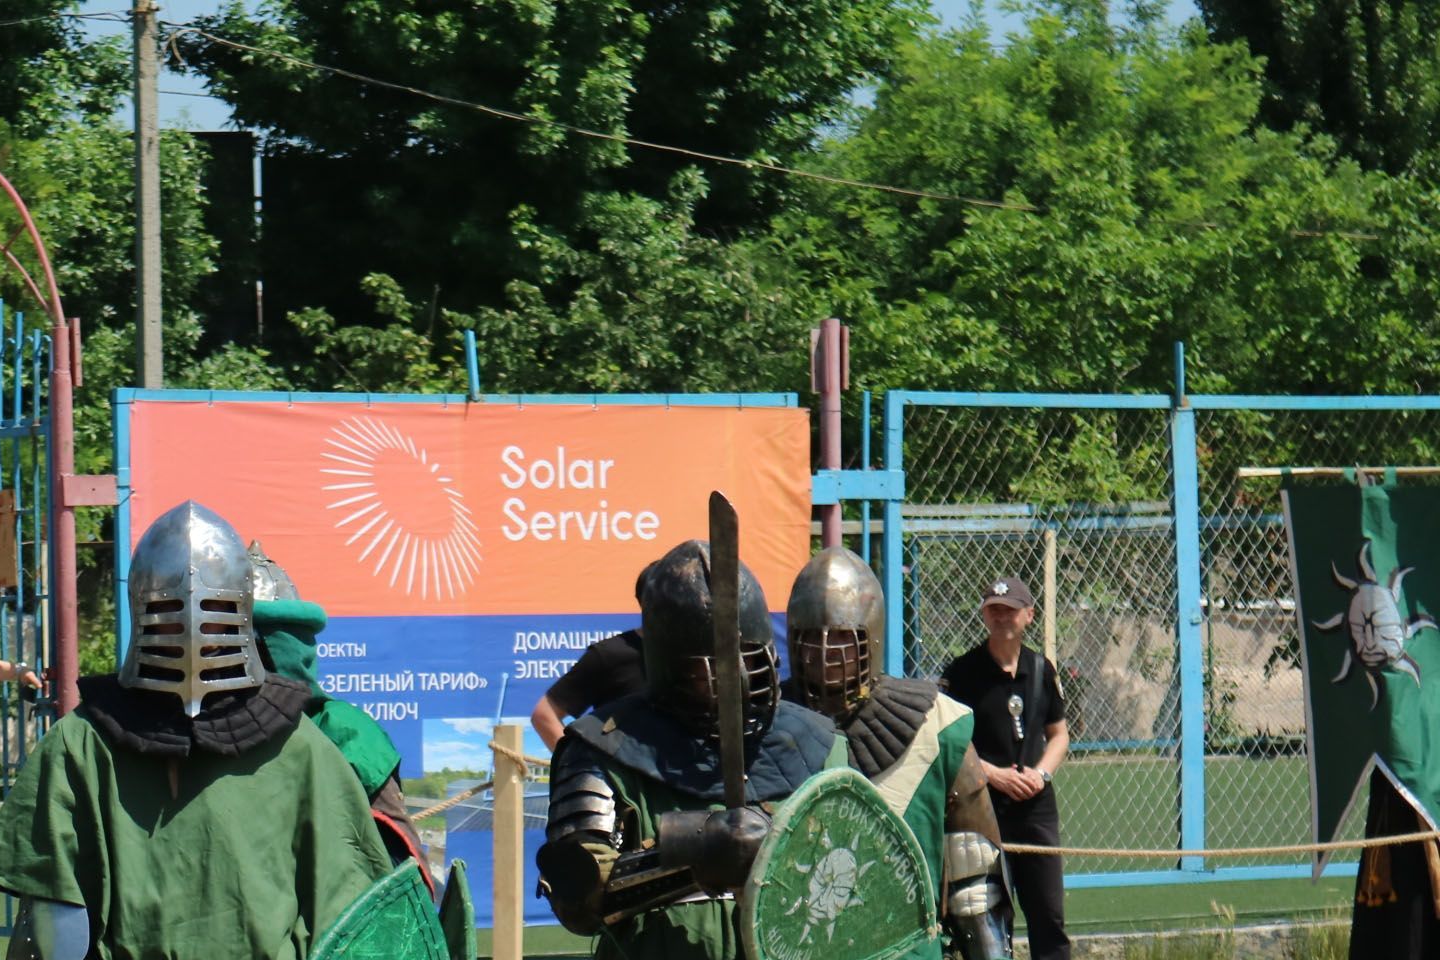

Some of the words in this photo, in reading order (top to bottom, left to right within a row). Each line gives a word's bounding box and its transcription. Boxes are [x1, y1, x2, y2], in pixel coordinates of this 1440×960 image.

[500, 445, 615, 490] Solar
[501, 497, 661, 542] Service
[513, 631, 623, 653] ДОМАШН
[514, 660, 578, 679] ЭЛЕКТ
[417, 672, 488, 691] ТАРИФ»
[363, 702, 418, 721] КЛЮЧ
